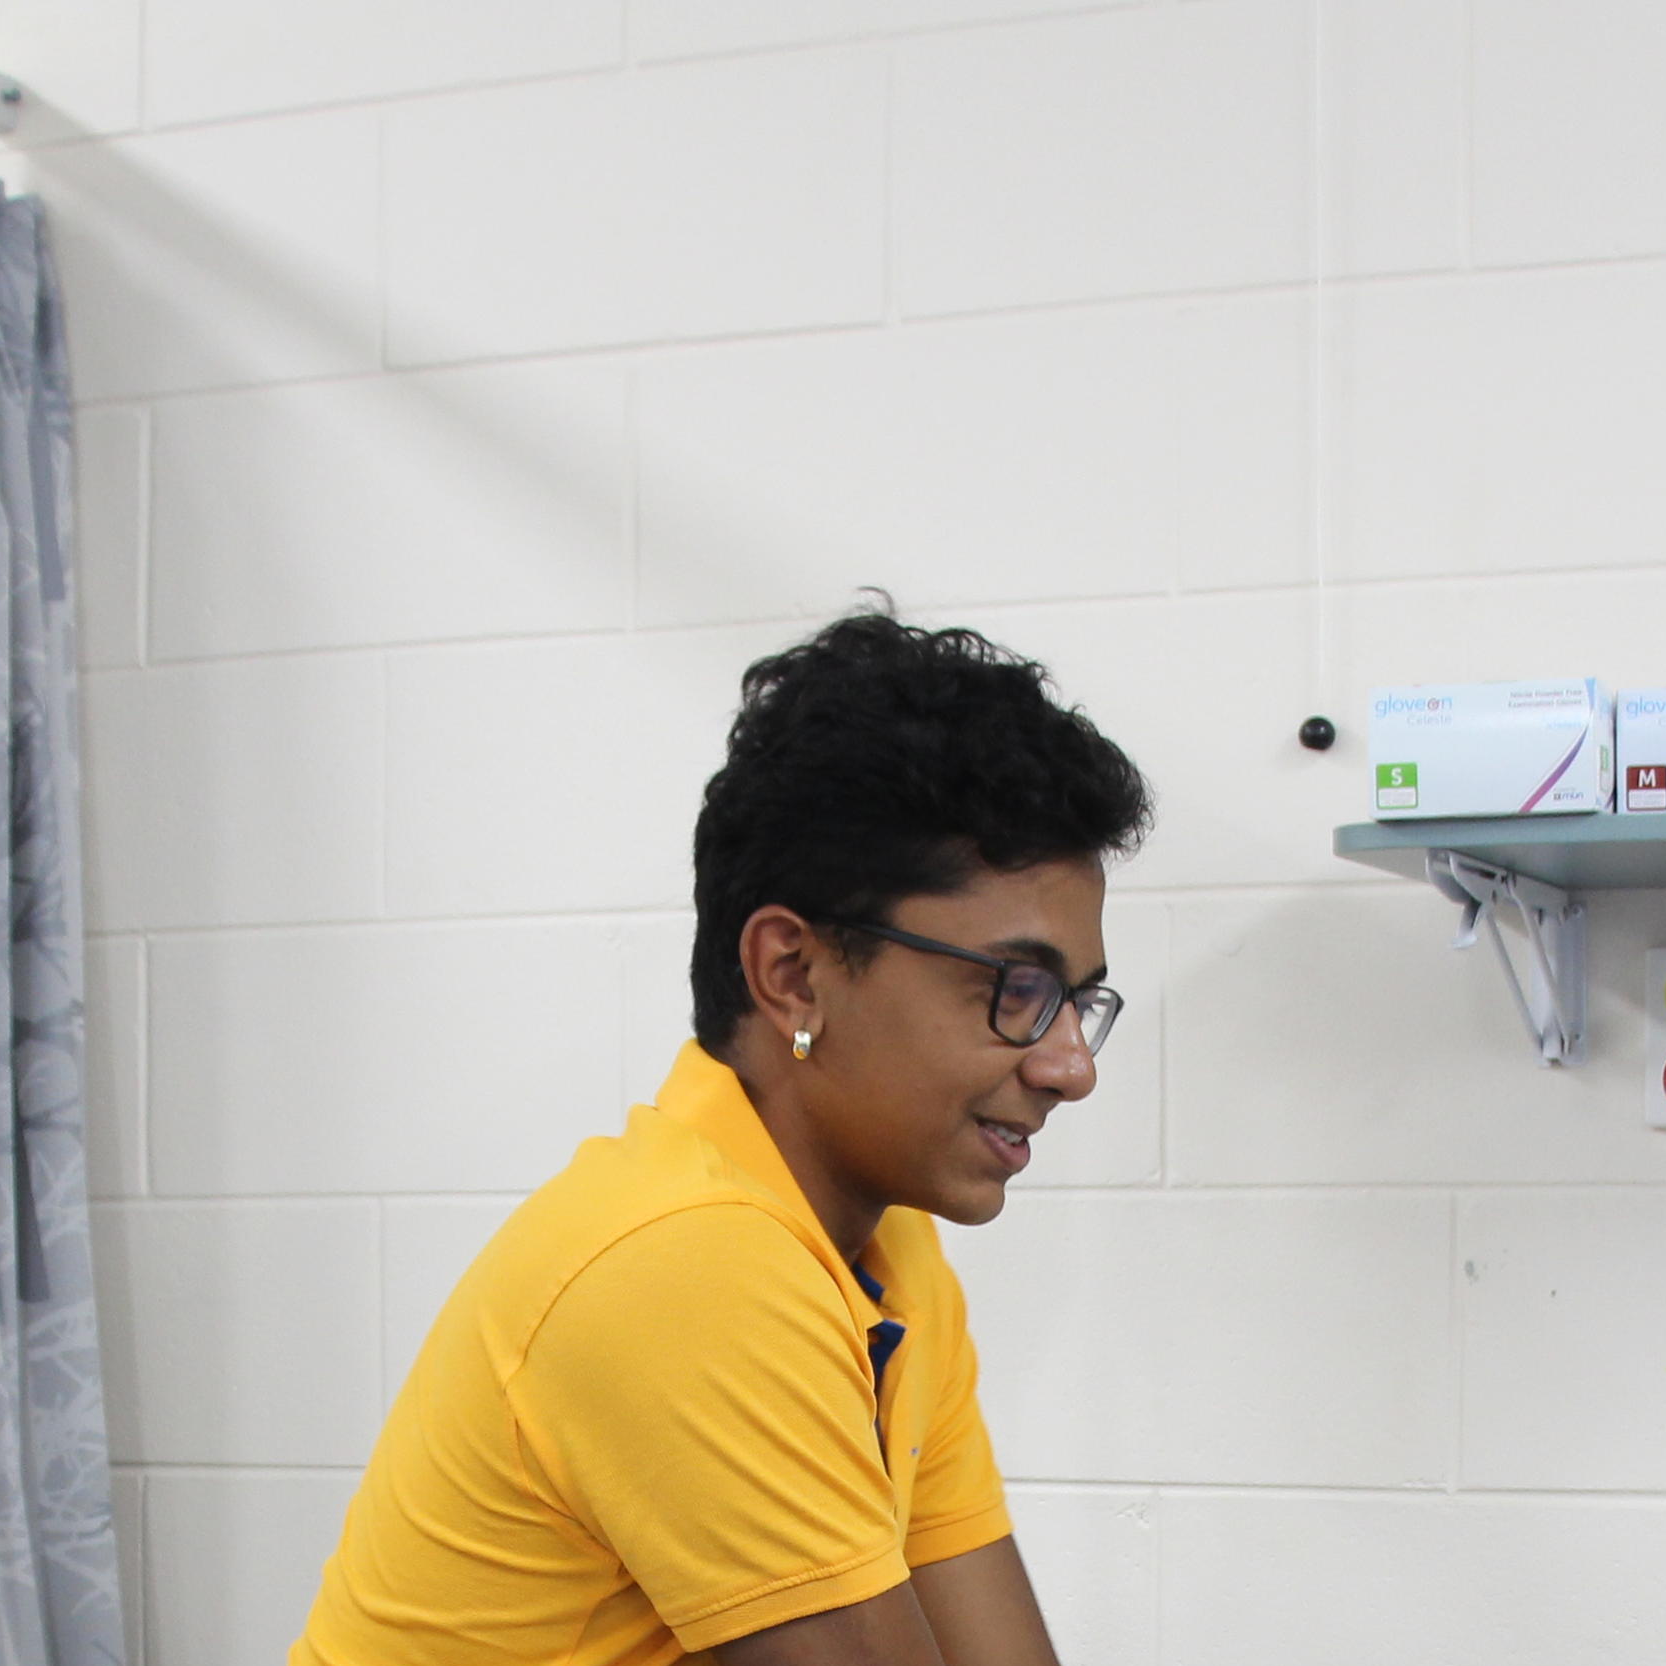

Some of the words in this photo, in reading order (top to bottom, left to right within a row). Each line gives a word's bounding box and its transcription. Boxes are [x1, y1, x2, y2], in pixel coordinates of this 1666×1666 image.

[1407, 715, 1453, 726] Celeste
[1391, 767, 1403, 786] S
[1638, 769, 1657, 788] M
